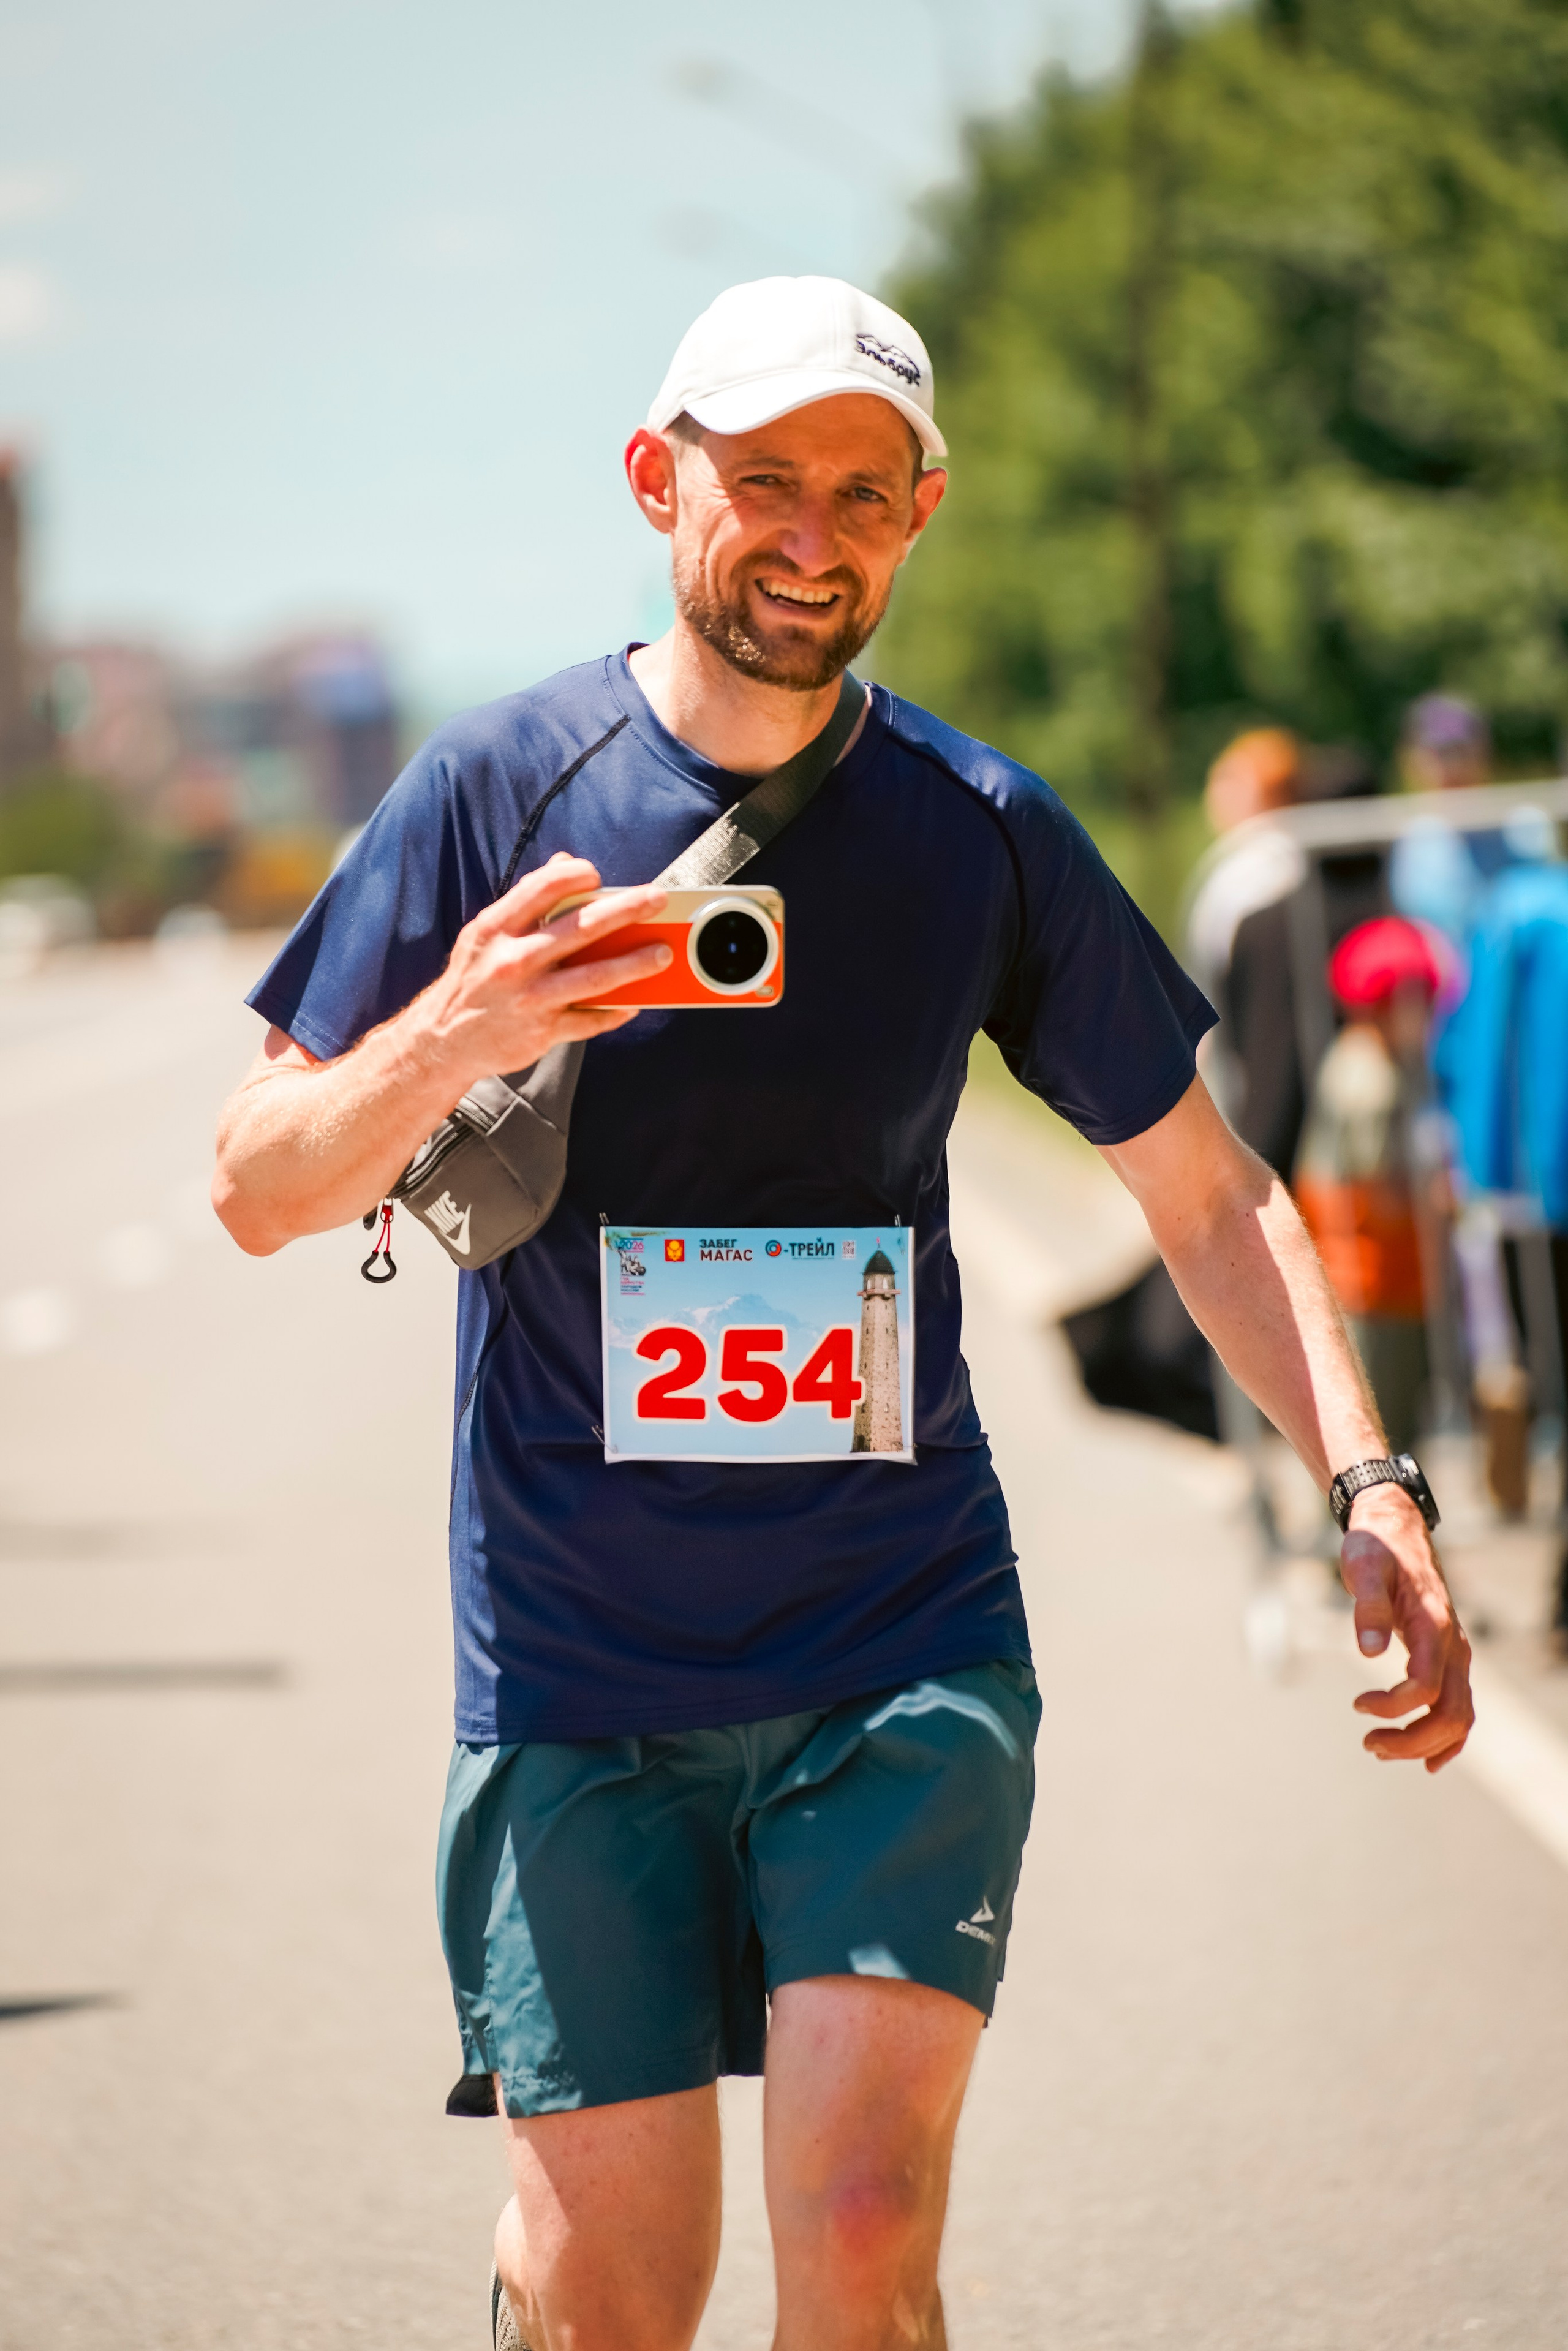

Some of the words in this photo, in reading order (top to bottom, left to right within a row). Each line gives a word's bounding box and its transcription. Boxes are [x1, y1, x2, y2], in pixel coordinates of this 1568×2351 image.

[424, 1190, 466, 1234] NIKE
[619, 1240, 644, 1250] 2026
[699, 1239, 737, 1248] ЗАБЕГ
[700, 1249, 753, 1261] МАГАС
[636, 1327, 862, 1422] 254
